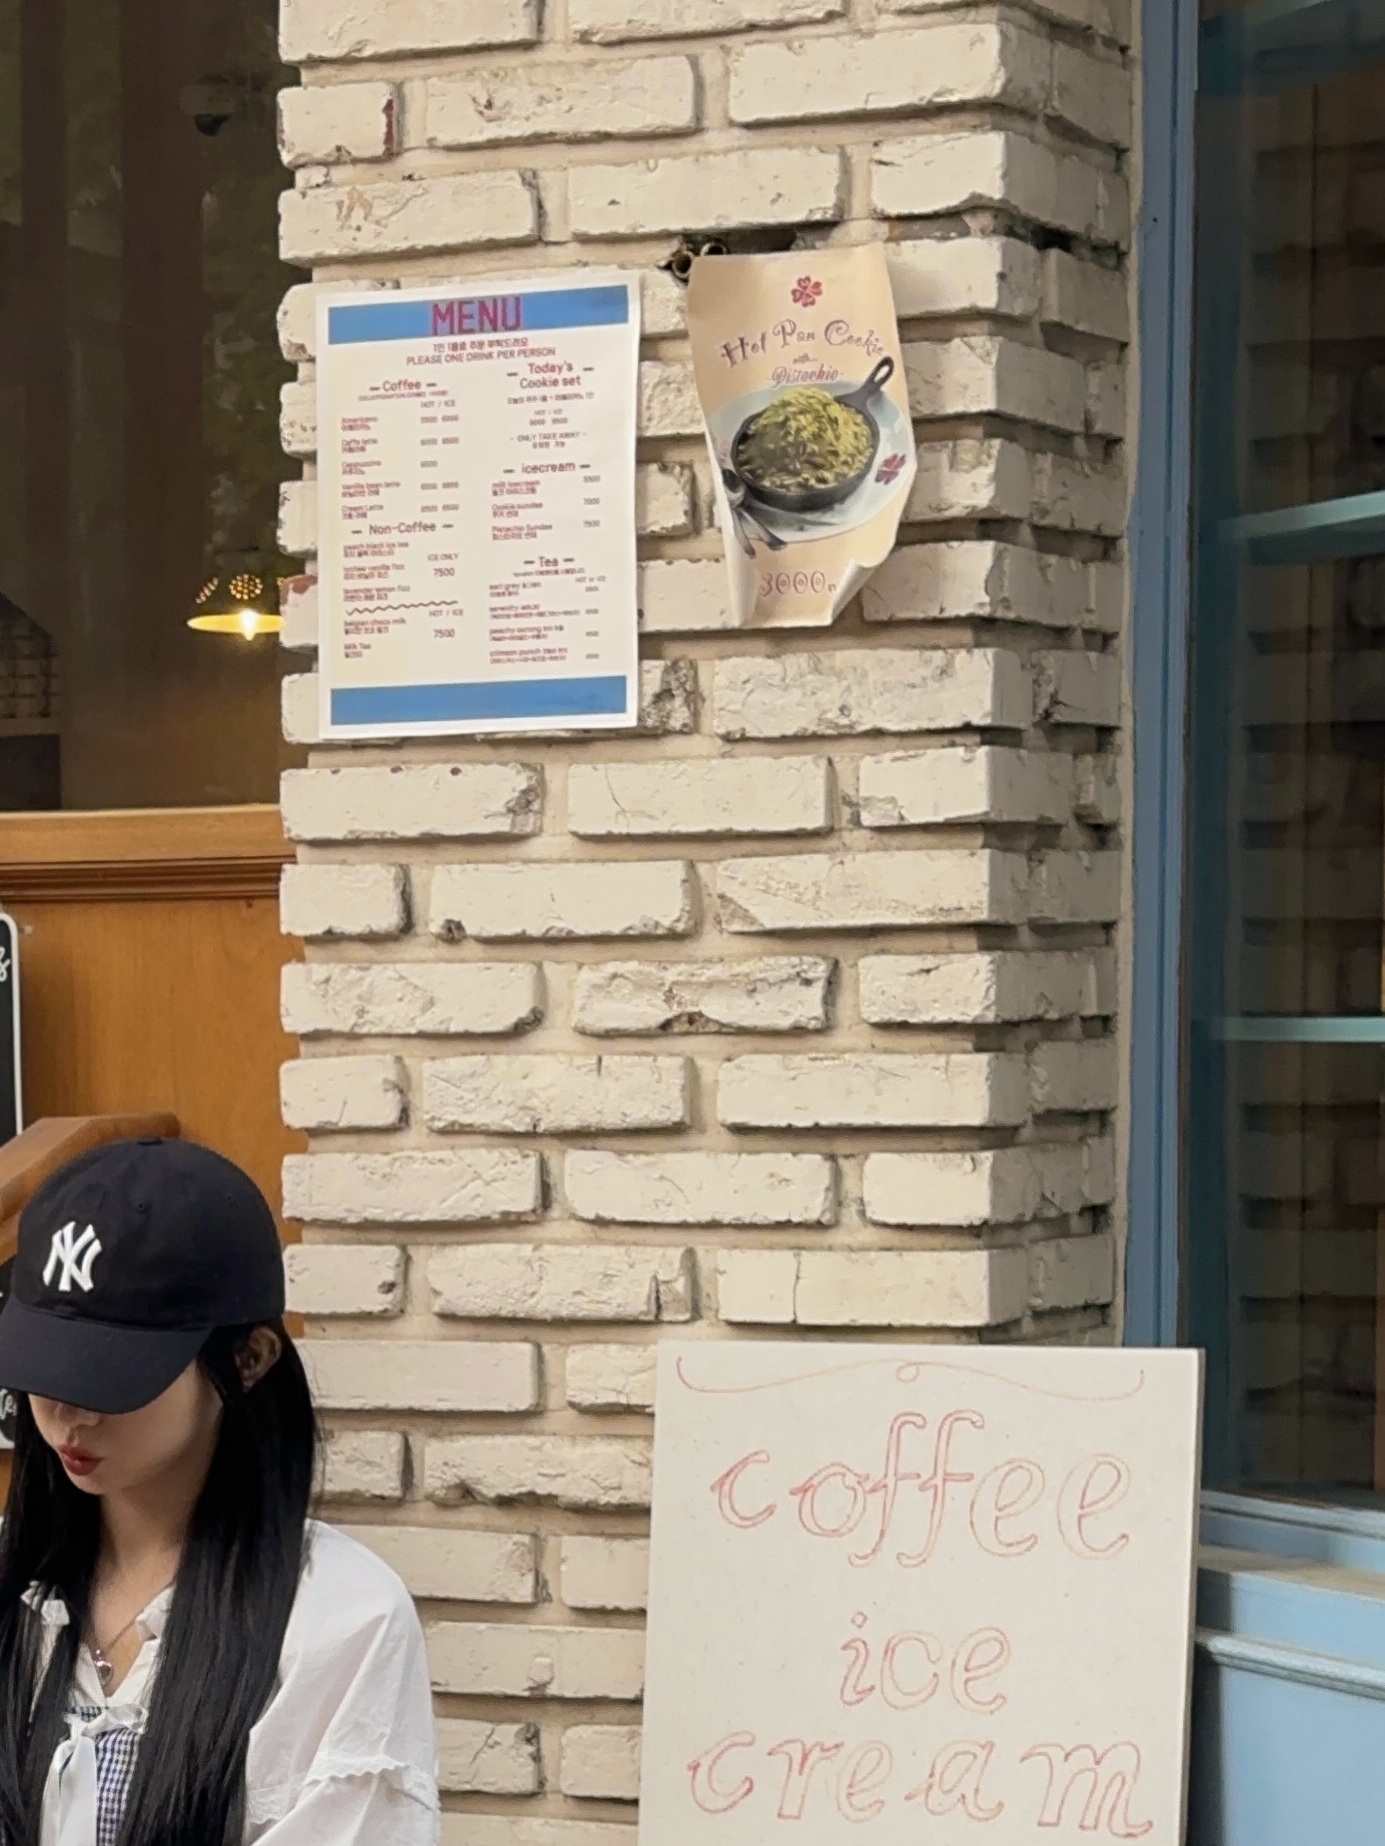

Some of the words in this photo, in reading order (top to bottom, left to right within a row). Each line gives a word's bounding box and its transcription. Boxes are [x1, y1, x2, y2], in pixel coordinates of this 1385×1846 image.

[431, 296, 522, 336] MENU
[720, 330, 767, 368] Hot
[772, 318, 815, 349] Pan
[824, 319, 885, 357] Cookie
[406, 354, 443, 365] PLEASE
[444, 353, 464, 363] ONE
[466, 351, 494, 362] DRINK
[497, 349, 515, 359] PER
[517, 347, 556, 358] PERSON
[528, 360, 573, 375] Today's
[383, 380, 421, 391] Coffee
[520, 376, 559, 389] Cookie
[562, 374, 581, 386] set
[522, 462, 575, 473] icecream
[369, 521, 436, 535] Non-Coffee
[538, 556, 559, 567] Tea
[434, 568, 455, 577] 7500
[434, 629, 455, 638] 7500
[42, 1221, 102, 1292] NY
[711, 1409, 1132, 1568] coffee
[839, 1611, 1011, 1714] ice
[688, 1732, 1153, 1838] cream
